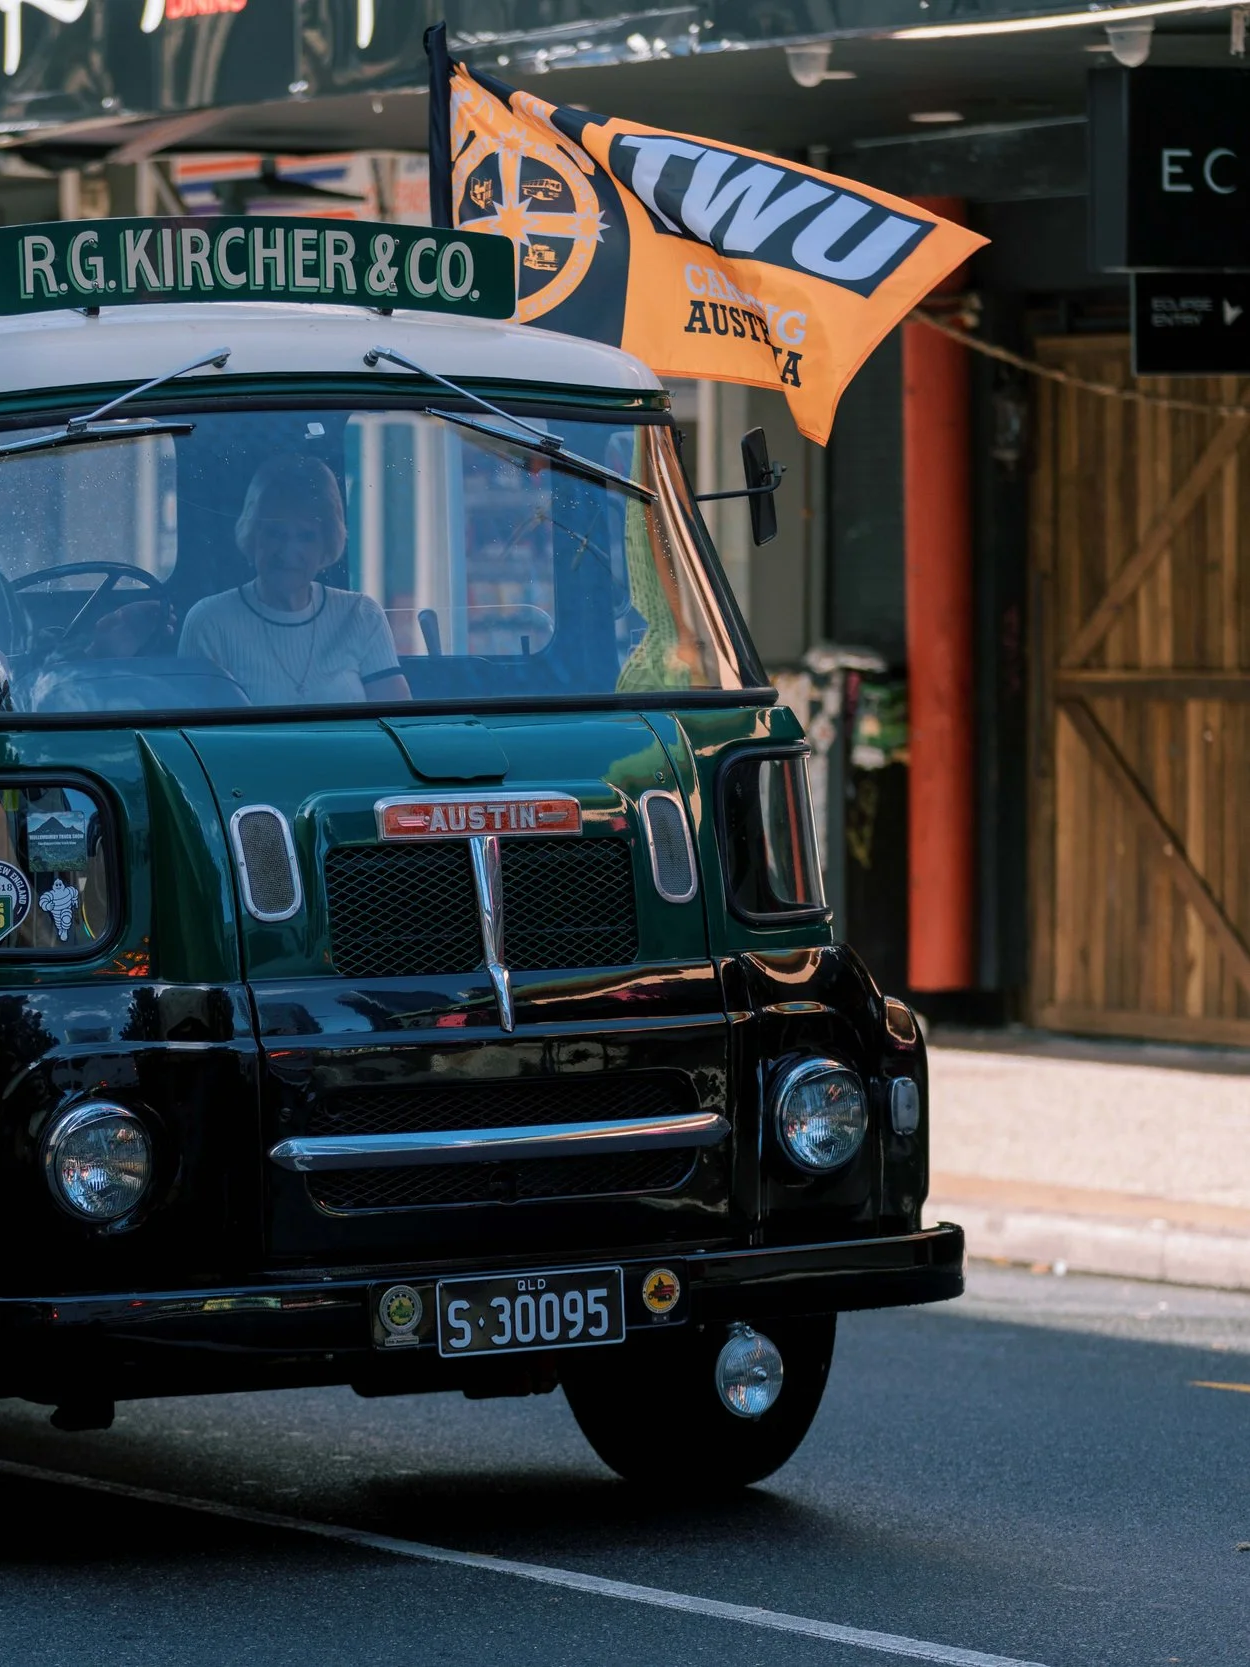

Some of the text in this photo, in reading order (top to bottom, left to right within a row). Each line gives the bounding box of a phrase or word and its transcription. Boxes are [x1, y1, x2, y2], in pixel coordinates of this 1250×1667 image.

[619, 135, 923, 280] TWU
[684, 300, 803, 388] AUSTRA
[429, 805, 537, 832] AUSTIN
[9, 872, 28, 905] ENGLAND
[517, 1278, 547, 1291] QLD
